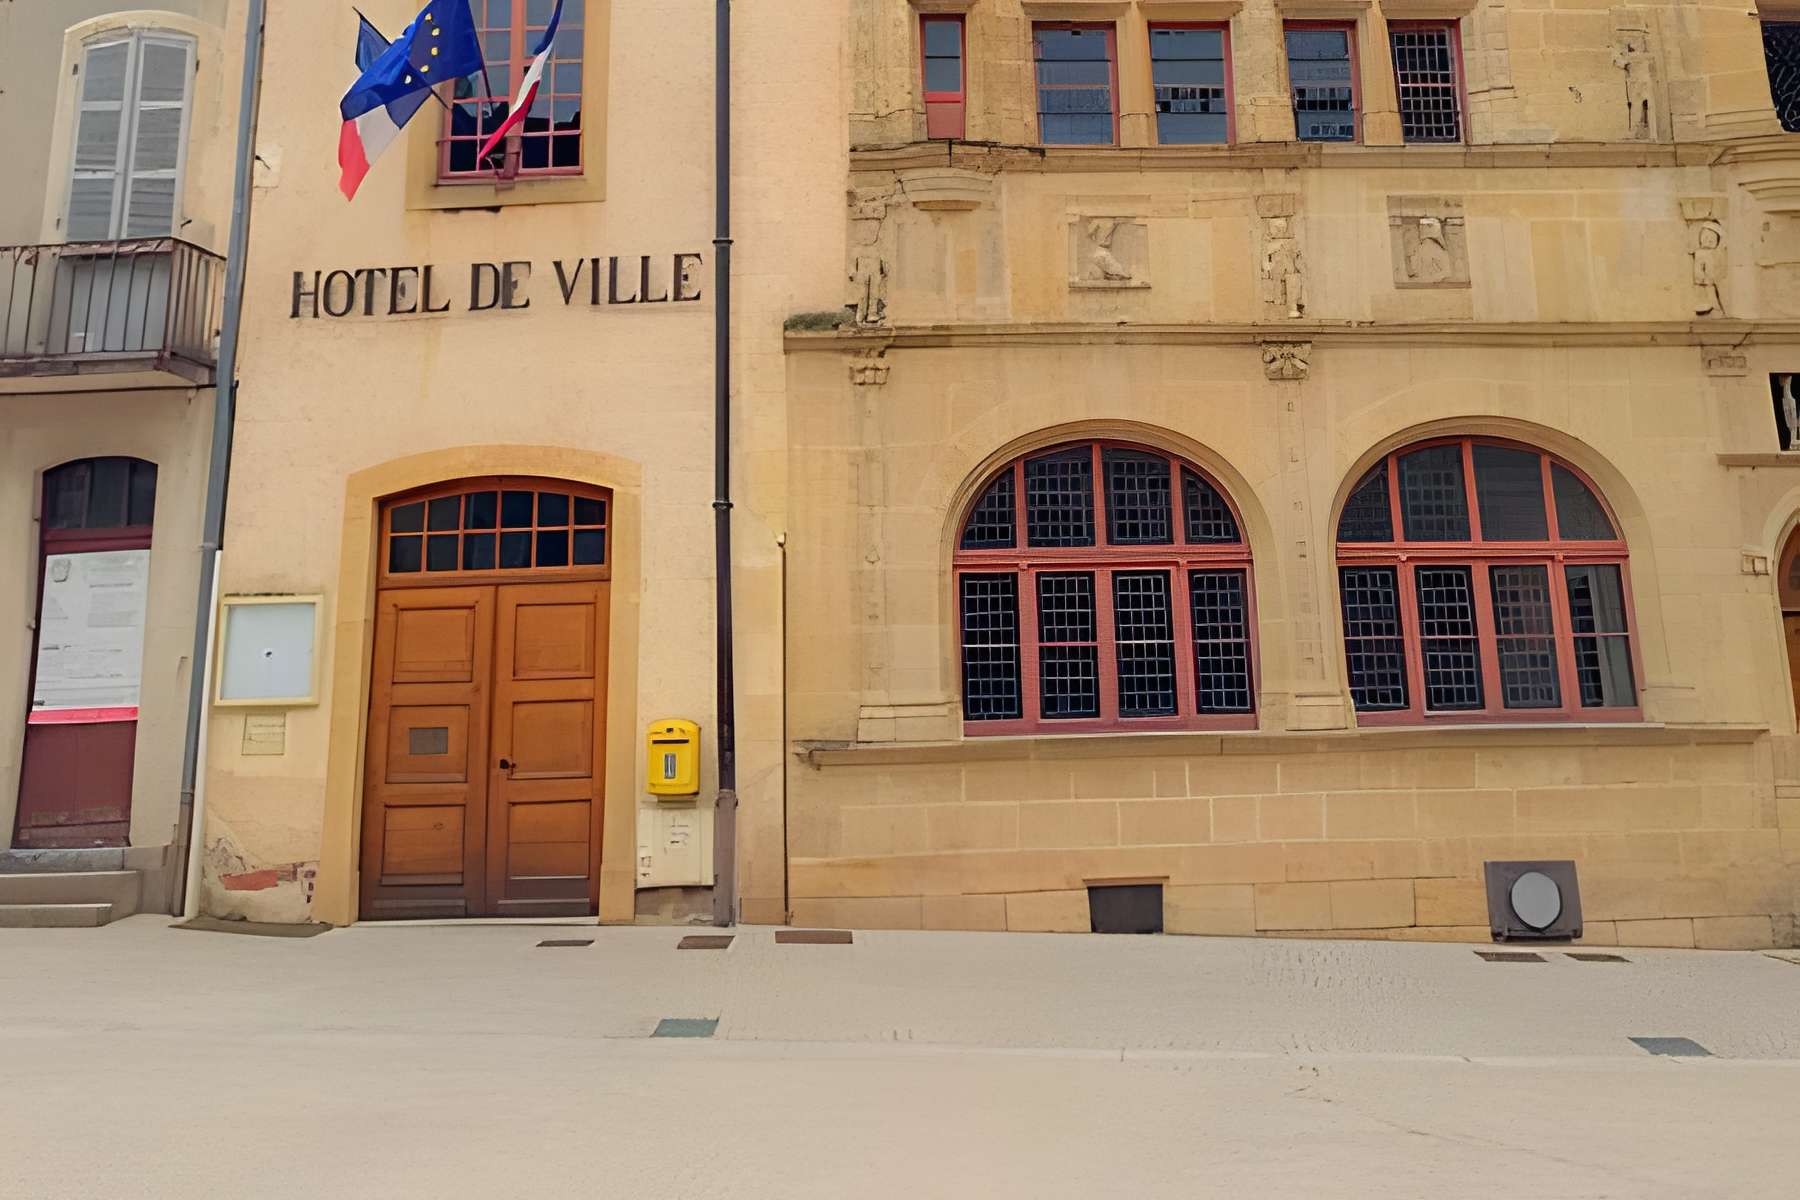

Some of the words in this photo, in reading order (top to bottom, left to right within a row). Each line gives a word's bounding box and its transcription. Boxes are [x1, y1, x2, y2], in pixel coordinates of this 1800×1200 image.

[290, 265, 450, 319] HOTEL
[468, 261, 531, 311] DE
[552, 253, 703, 305] VILLE
